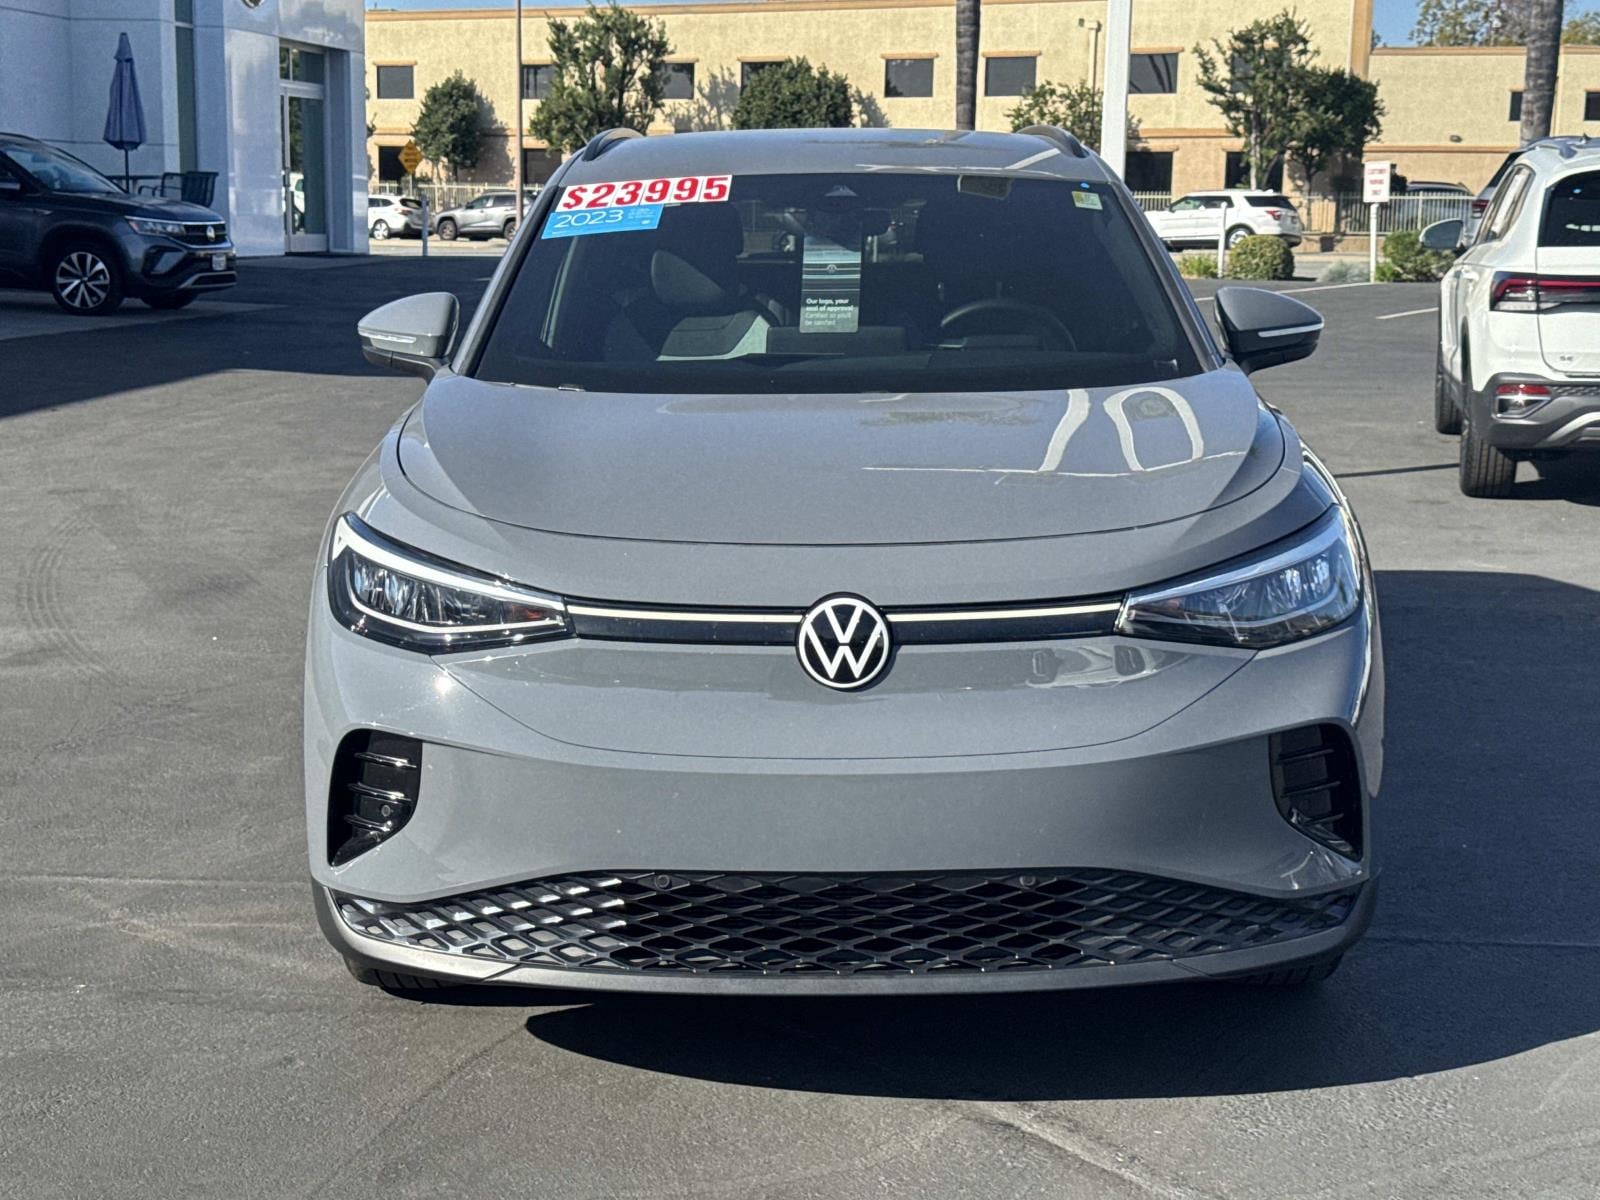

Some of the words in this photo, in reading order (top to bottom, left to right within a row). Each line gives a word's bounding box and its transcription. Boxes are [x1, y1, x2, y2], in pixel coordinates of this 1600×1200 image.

[563, 177, 728, 209] $23995
[554, 209, 624, 228] 2023
[819, 297, 834, 306] logo,
